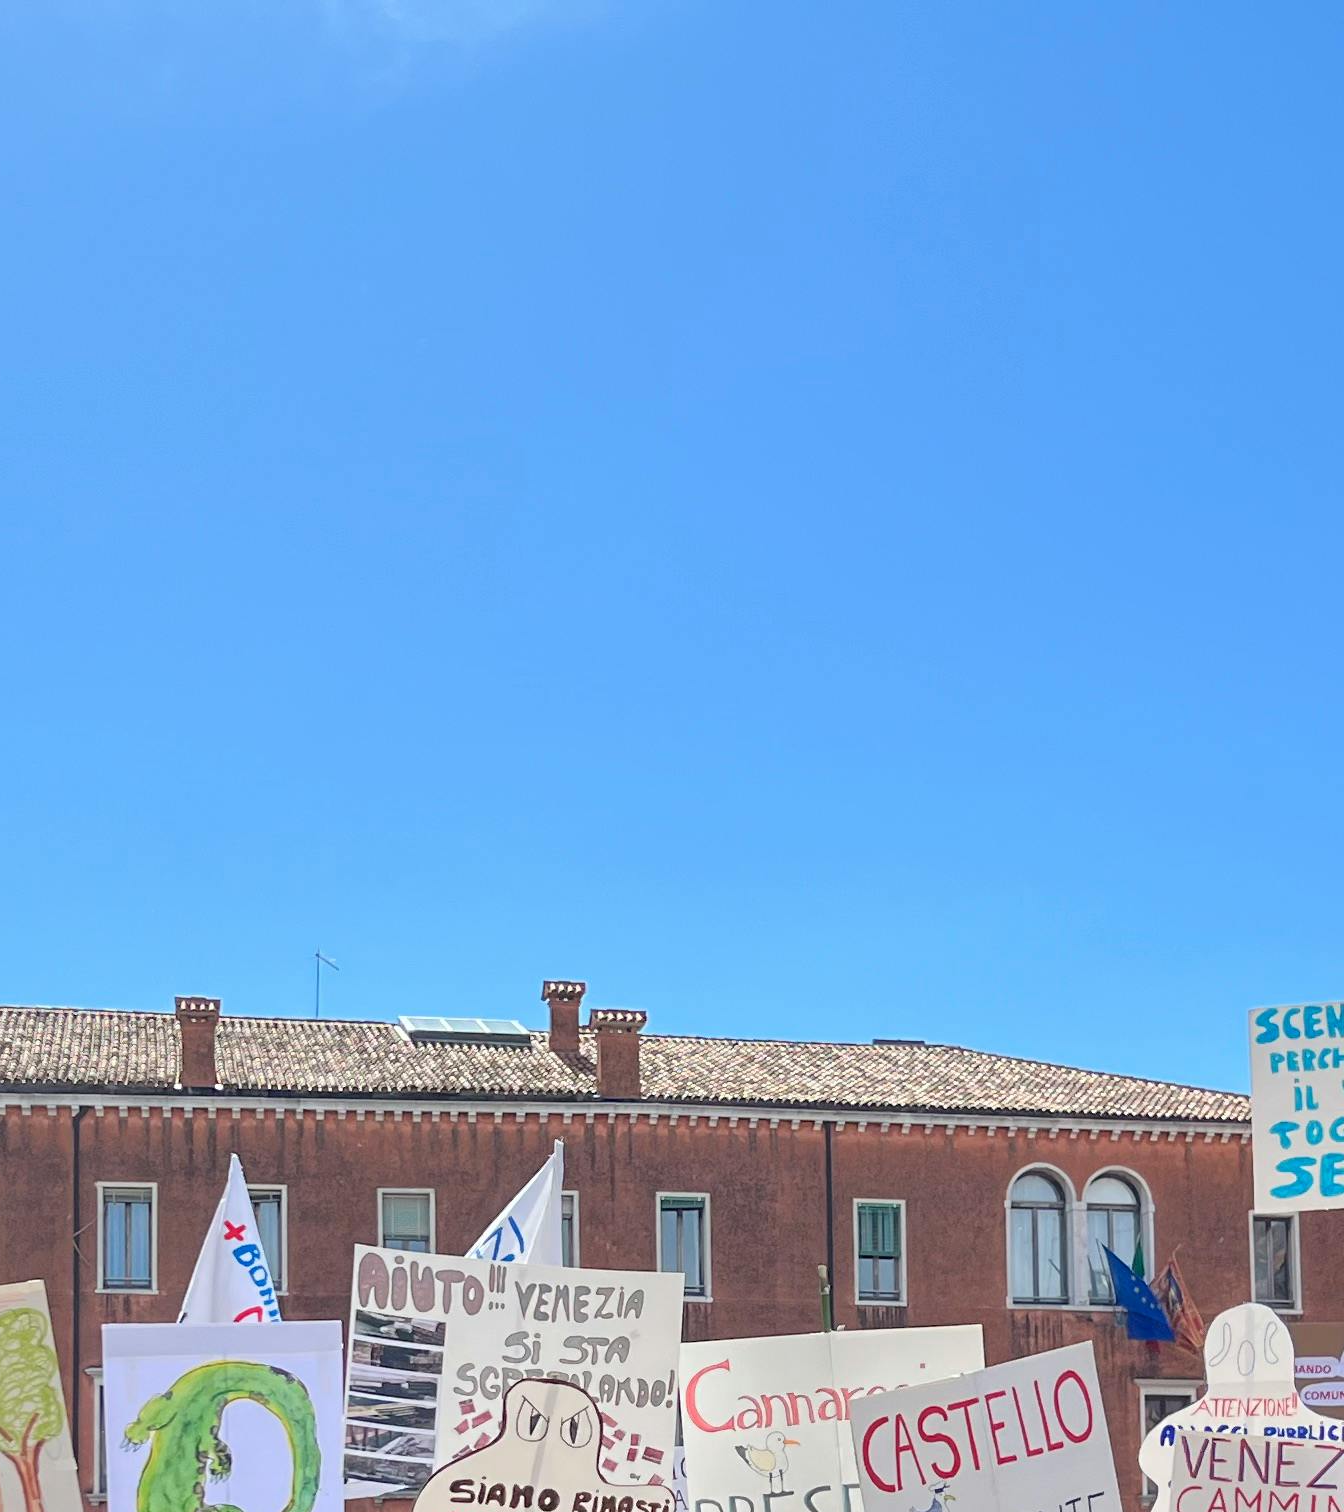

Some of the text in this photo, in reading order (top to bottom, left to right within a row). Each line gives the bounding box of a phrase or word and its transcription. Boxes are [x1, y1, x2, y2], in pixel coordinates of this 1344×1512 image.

[559, 1335, 631, 1366] STA
[862, 1369, 1093, 1493] CASTELLO
[449, 1476, 562, 1512] SIAMO
